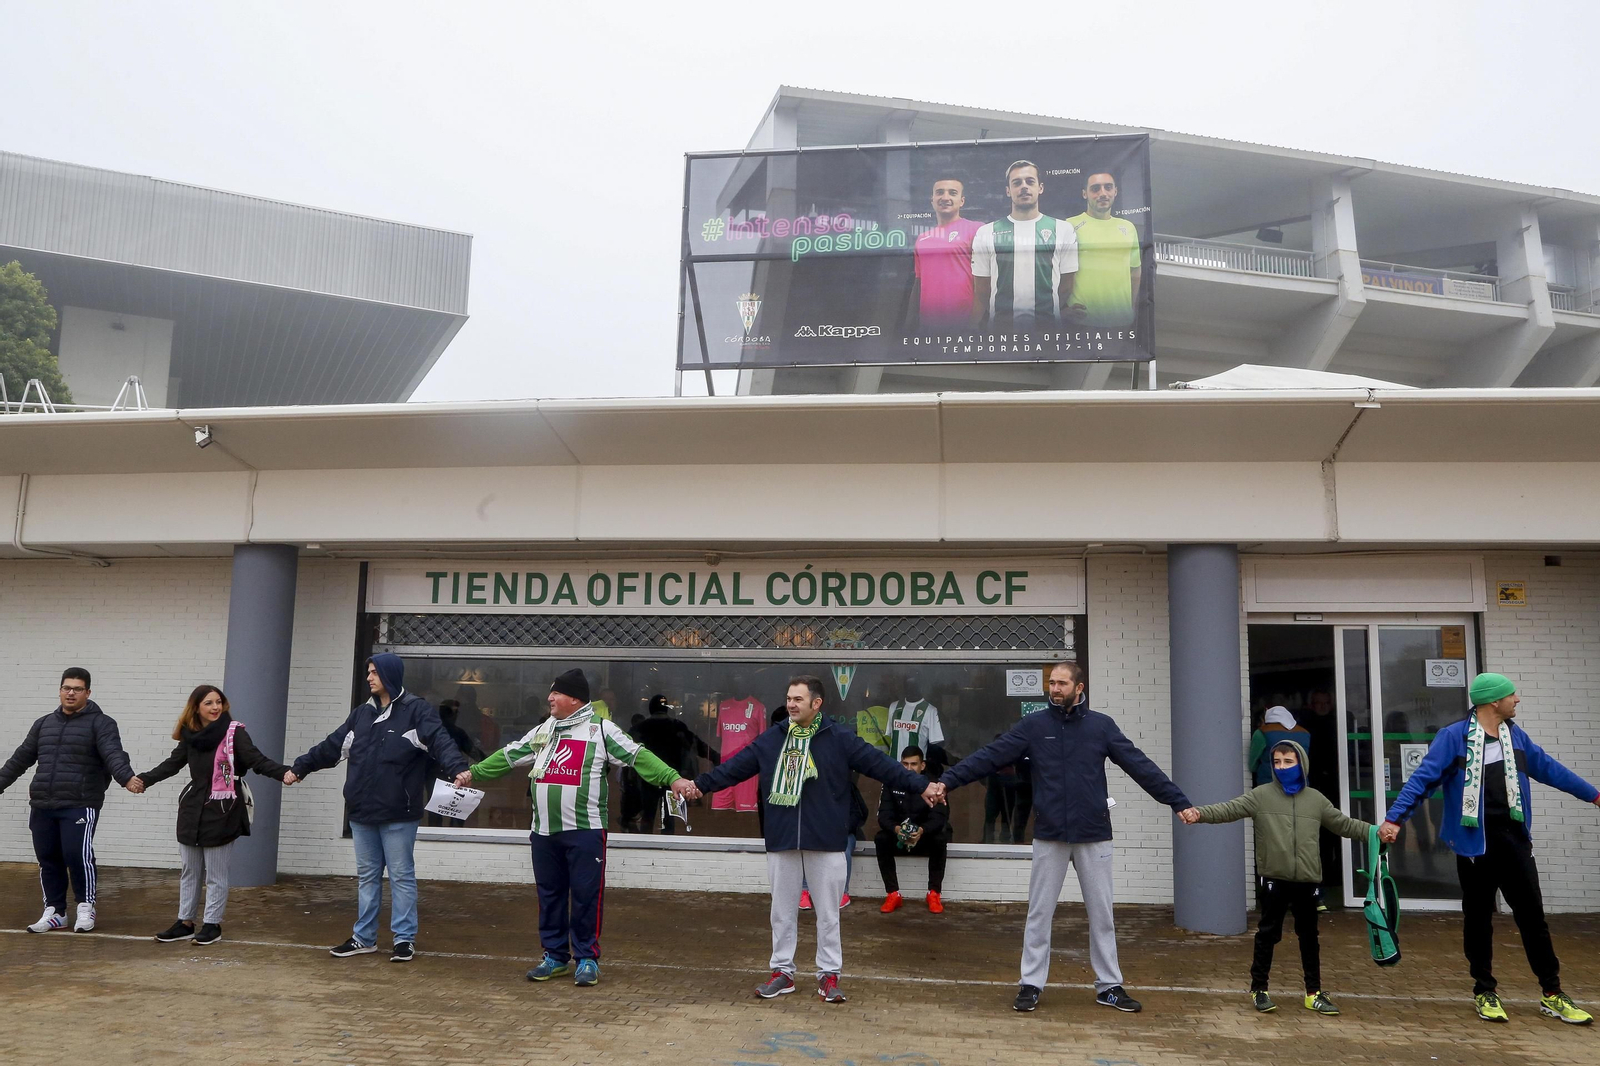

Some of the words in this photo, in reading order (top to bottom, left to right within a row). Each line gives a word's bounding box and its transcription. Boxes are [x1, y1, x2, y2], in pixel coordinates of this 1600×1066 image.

[1121, 206, 1151, 215] EQUIPACIÓN
[791, 223, 906, 262] pasión
[819, 325, 881, 338] Kappa
[725, 335, 771, 343] CÓRDOBA
[903, 333, 1030, 345] EQUIPACIONES
[1044, 330, 1136, 342] OFICIALES
[942, 344, 1042, 353] TEMPORADA
[1056, 343, 1103, 351] 17-18
[425, 571, 578, 605] TIENDA
[587, 571, 754, 606] OFICIAL
[766, 563, 965, 606] CÓRDOBA
[976, 570, 1028, 605] CF
[722, 722, 748, 733] tango
[894, 720, 918, 732] tango
[545, 765, 578, 776] ajaSur
